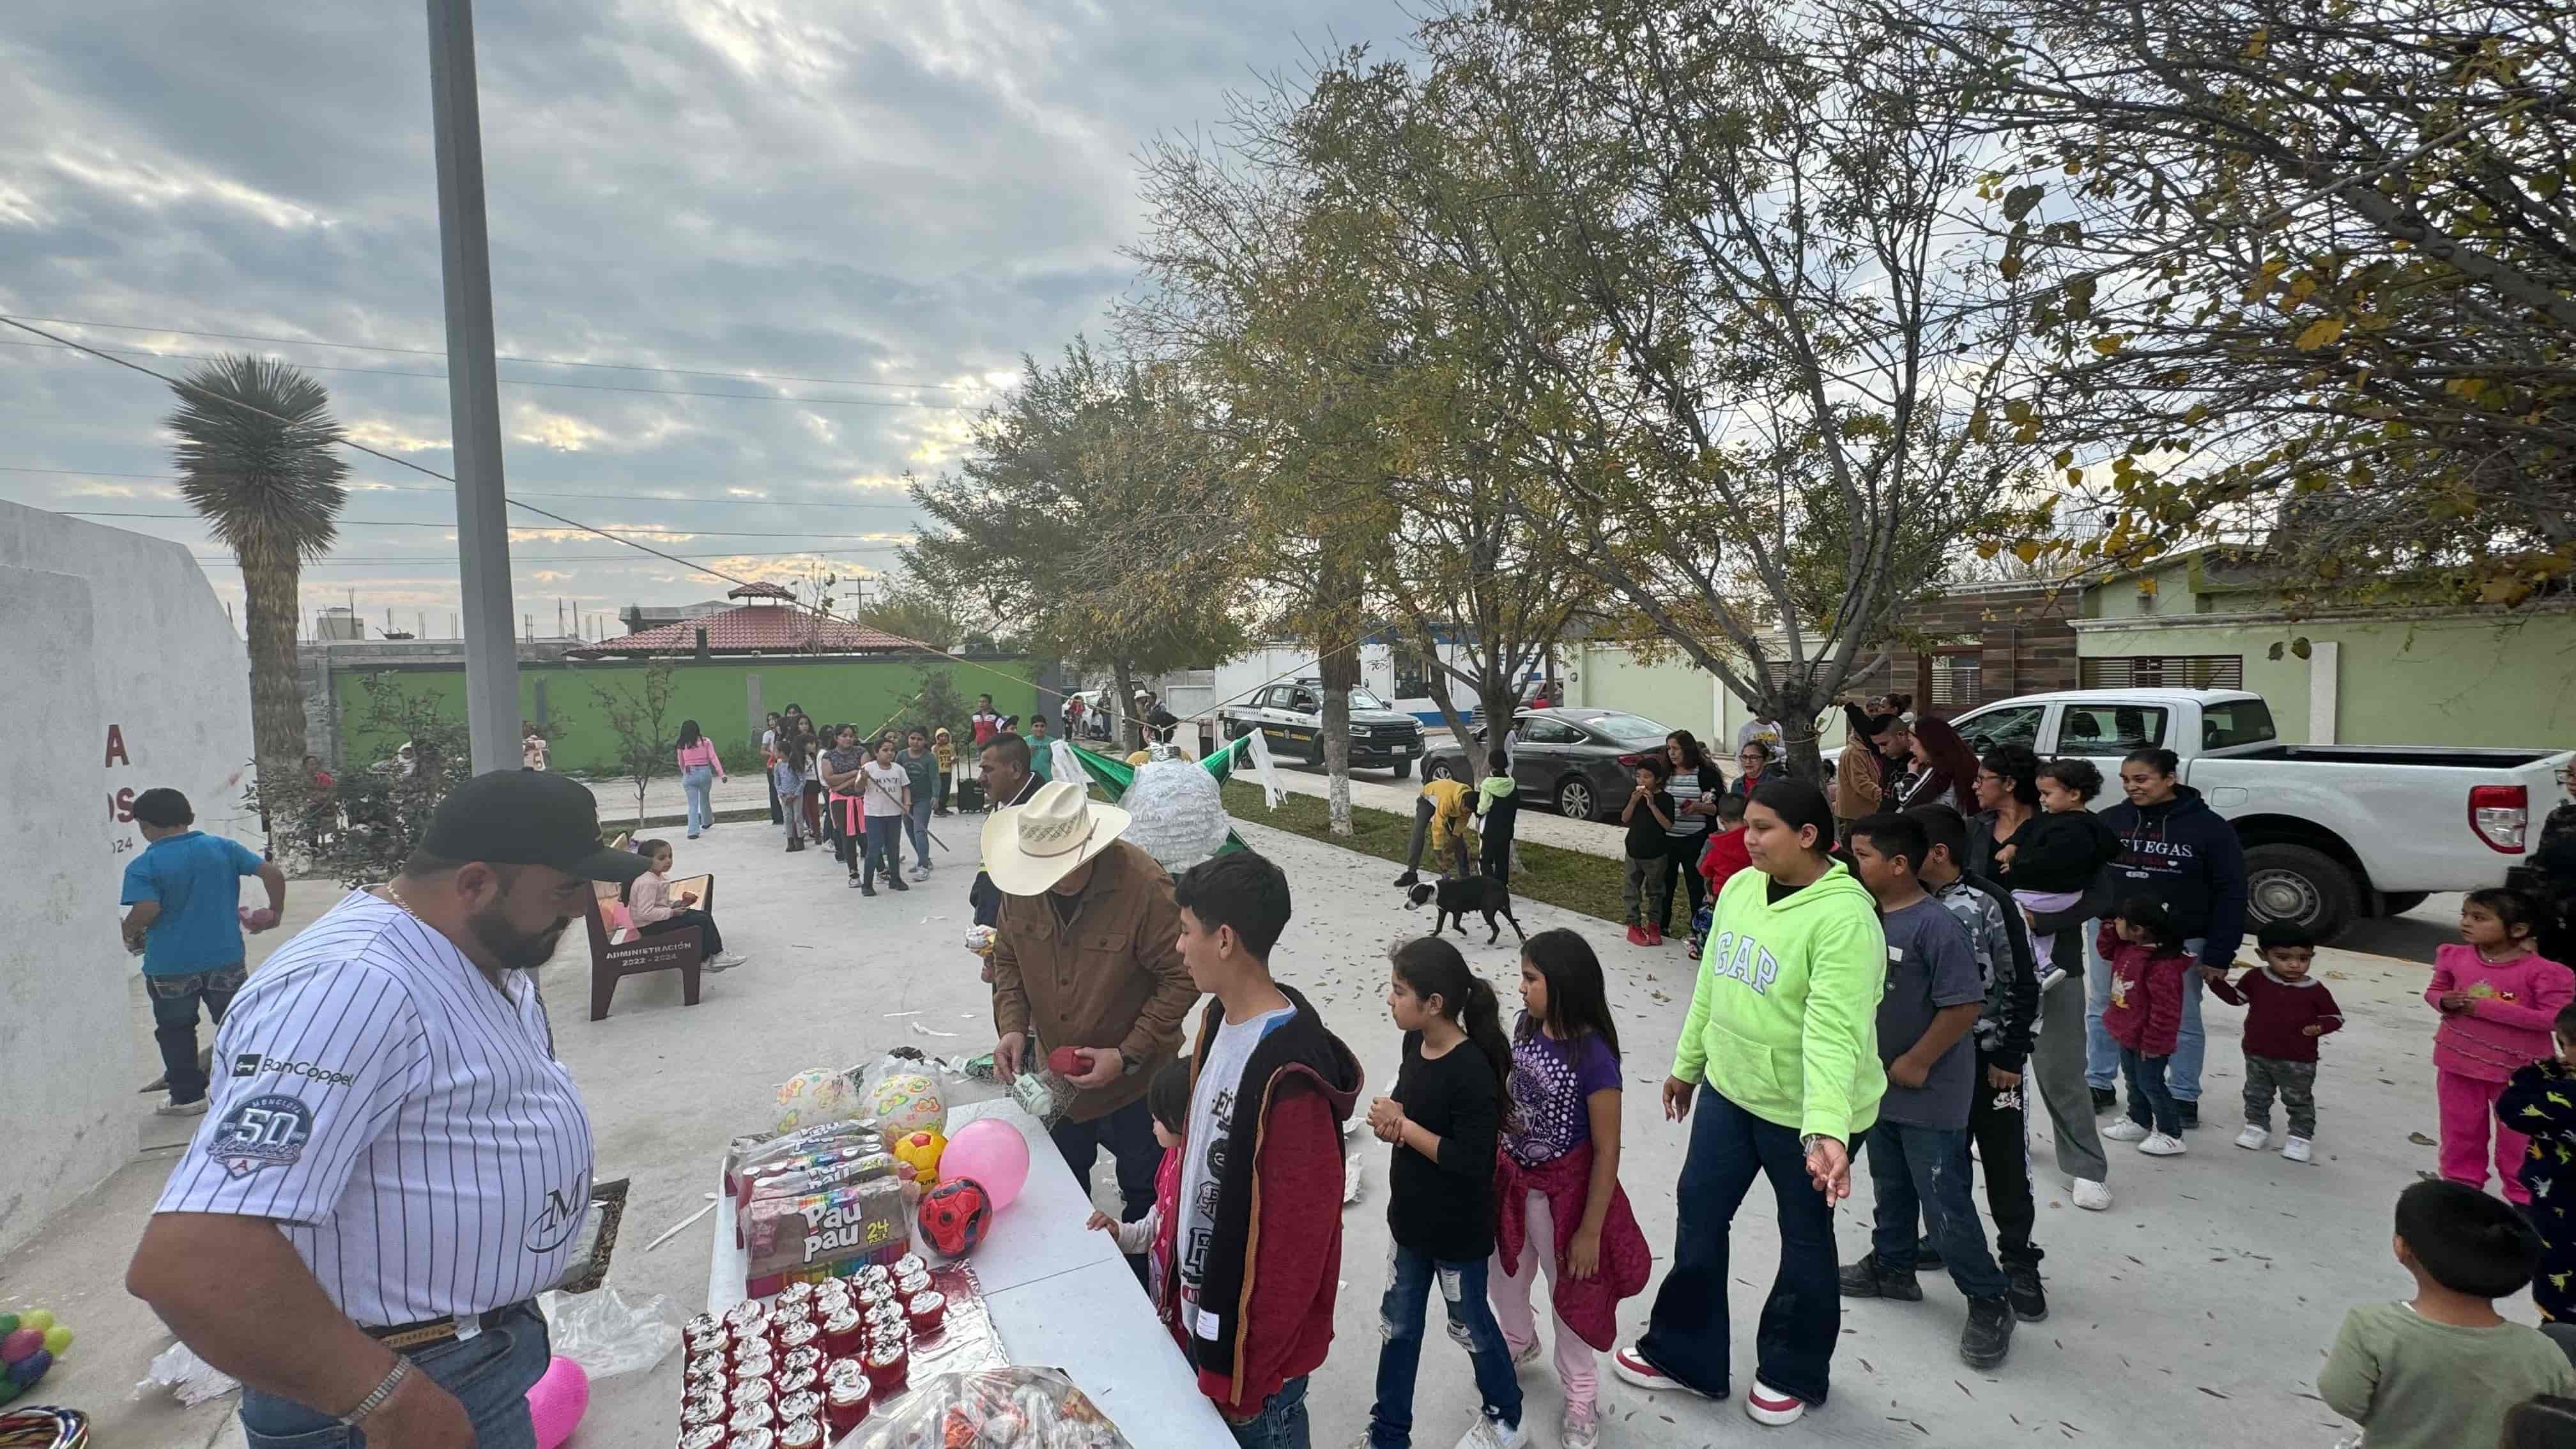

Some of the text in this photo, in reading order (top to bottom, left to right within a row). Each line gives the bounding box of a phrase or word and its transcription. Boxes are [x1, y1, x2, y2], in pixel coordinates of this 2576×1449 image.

[2131, 839, 2193, 857] VEGAS
[606, 941, 692, 959] ADMINISTRACIÓN
[622, 958, 646, 967] 2022
[654, 954, 677, 962] 2024
[1714, 931, 1778, 997] GAP
[261, 1057, 354, 1088] BanCoppel
[252, 1098, 303, 1114] MONCLOVA
[234, 1107, 300, 1147] 50
[799, 1202, 862, 1236] Pau
[867, 1219, 889, 1240] 24
[803, 1224, 859, 1263] pau
